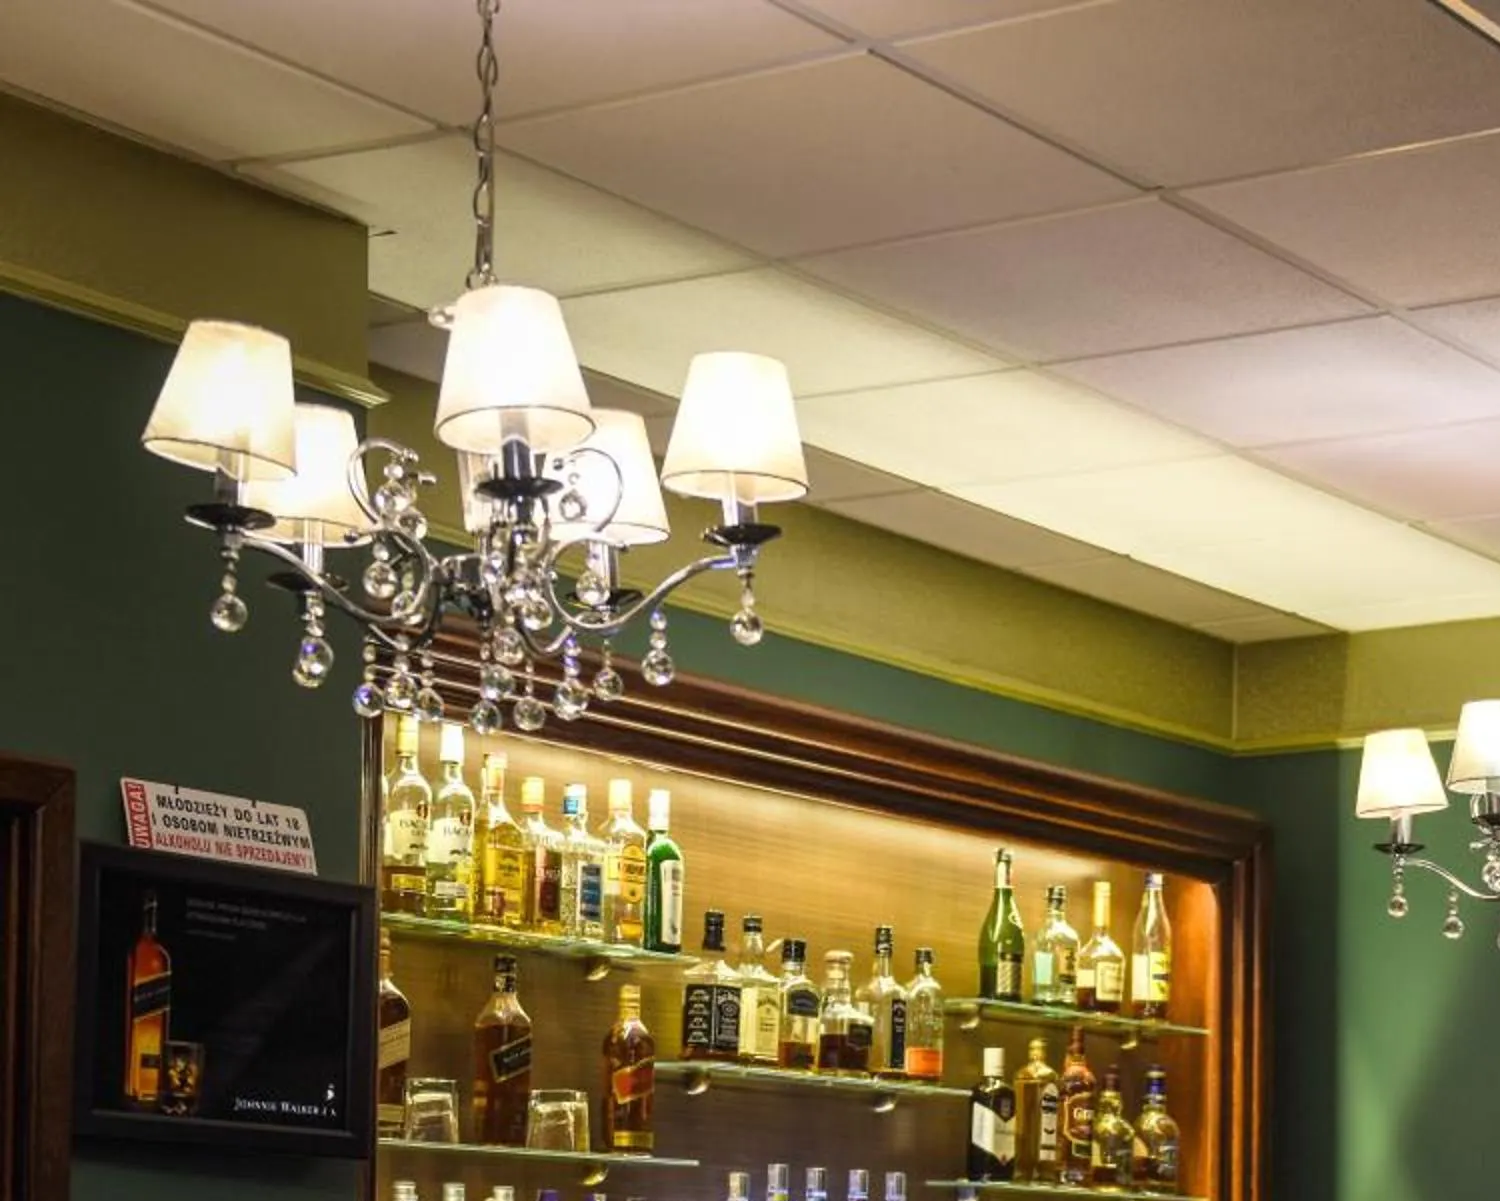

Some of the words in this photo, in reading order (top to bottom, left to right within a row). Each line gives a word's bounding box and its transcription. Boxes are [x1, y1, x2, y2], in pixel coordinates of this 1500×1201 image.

[162, 814, 219, 835] OSOBOM
[234, 809, 252, 822] DO
[258, 812, 279, 827] LAT
[154, 832, 211, 851] ALKOHOLU
[215, 841, 232, 856] NIE
